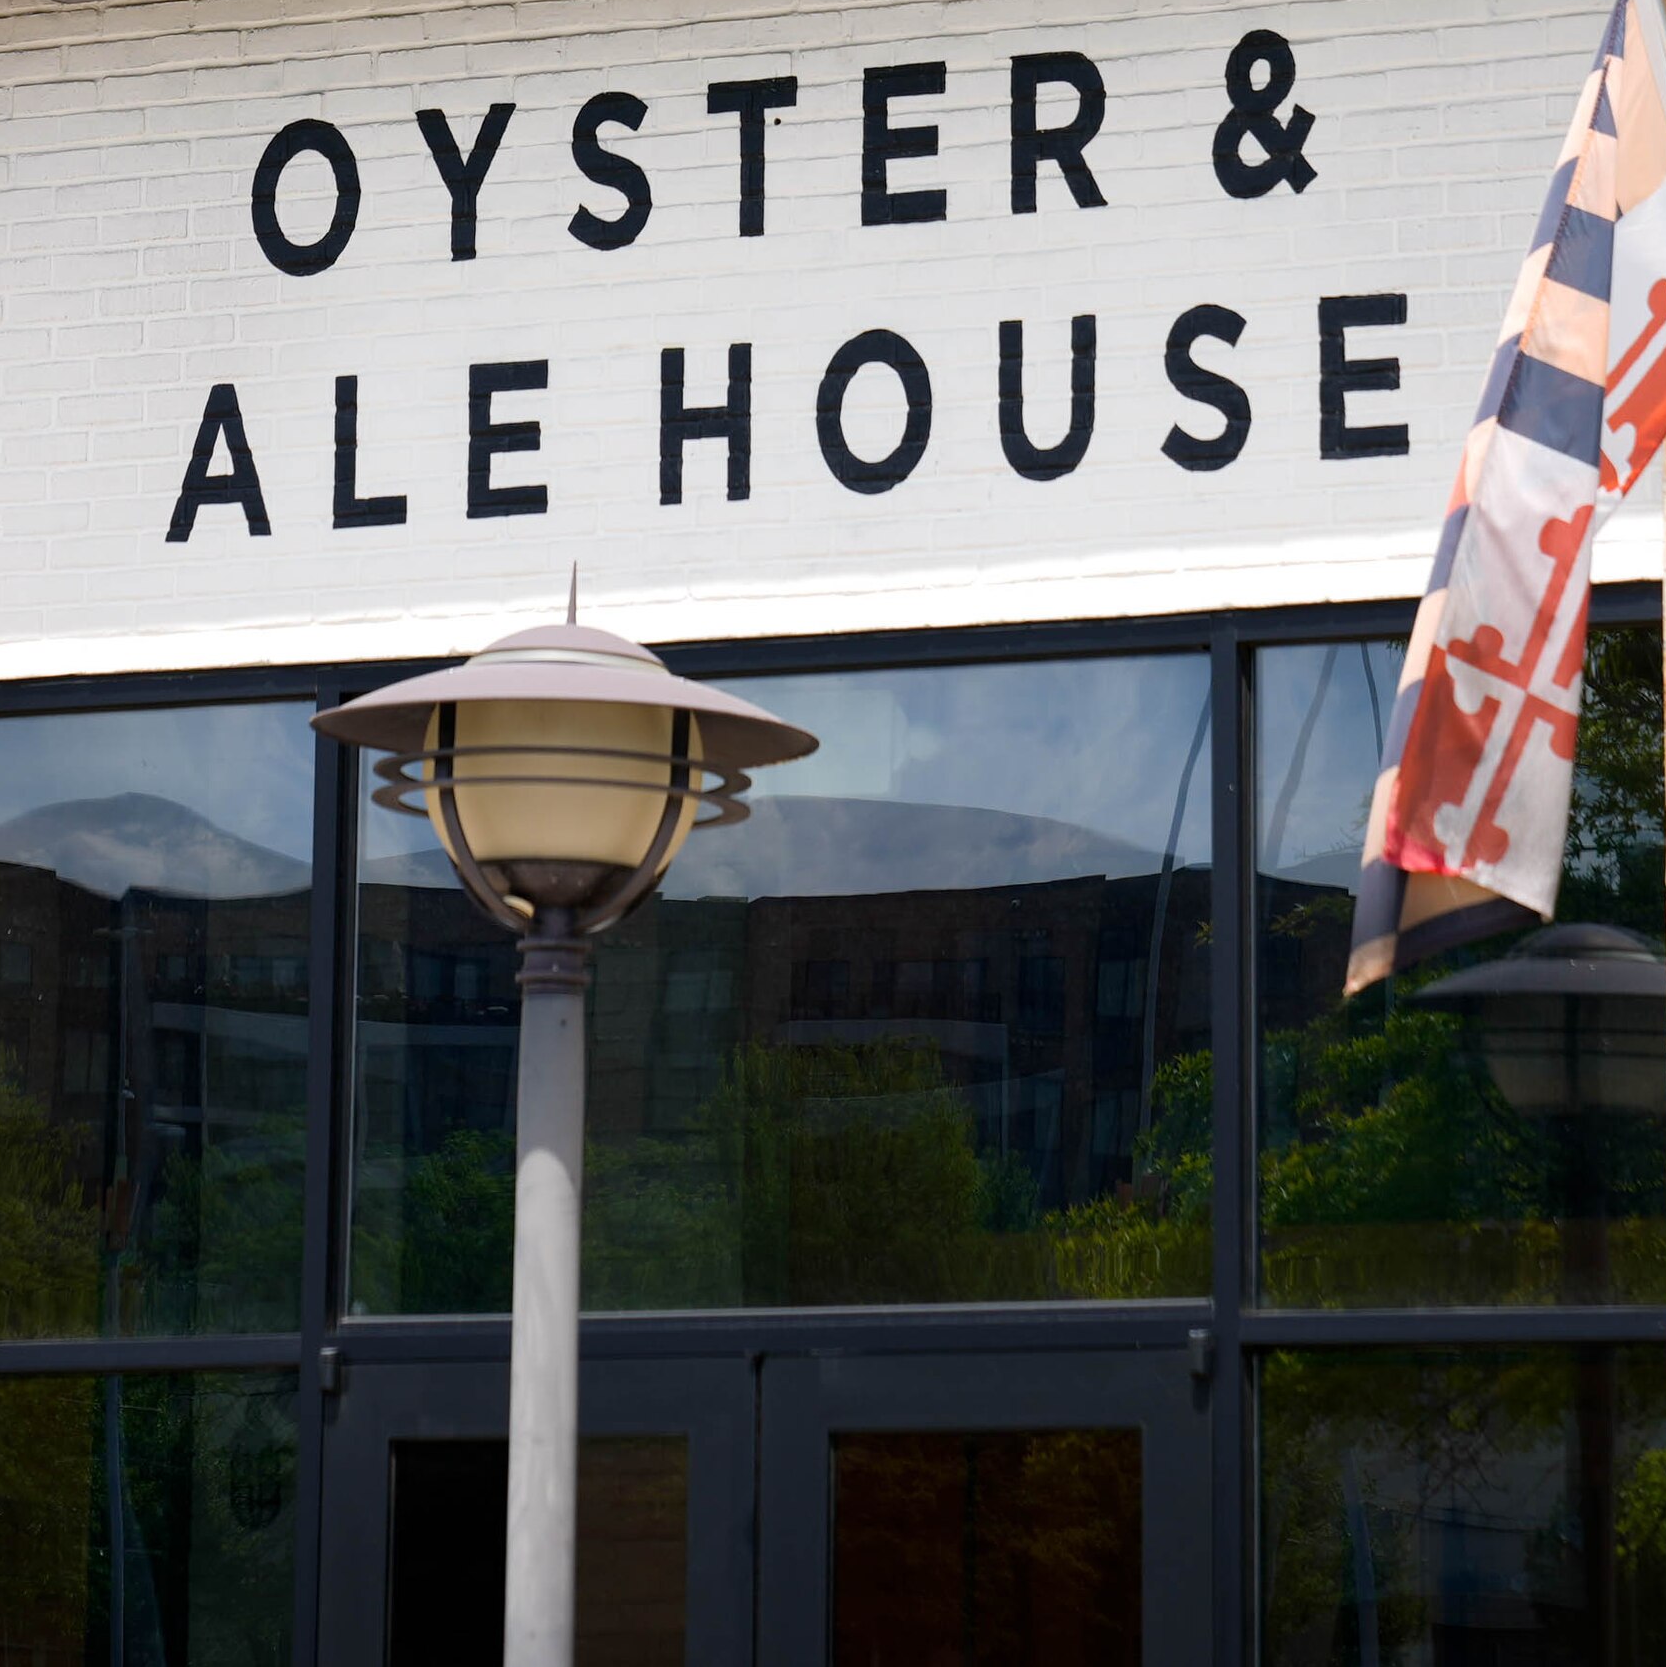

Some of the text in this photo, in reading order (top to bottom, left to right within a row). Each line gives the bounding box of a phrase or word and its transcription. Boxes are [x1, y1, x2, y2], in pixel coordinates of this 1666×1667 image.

[251, 28, 1319, 277] OYSTER &
[165, 292, 1410, 544] ALE HOUSE
